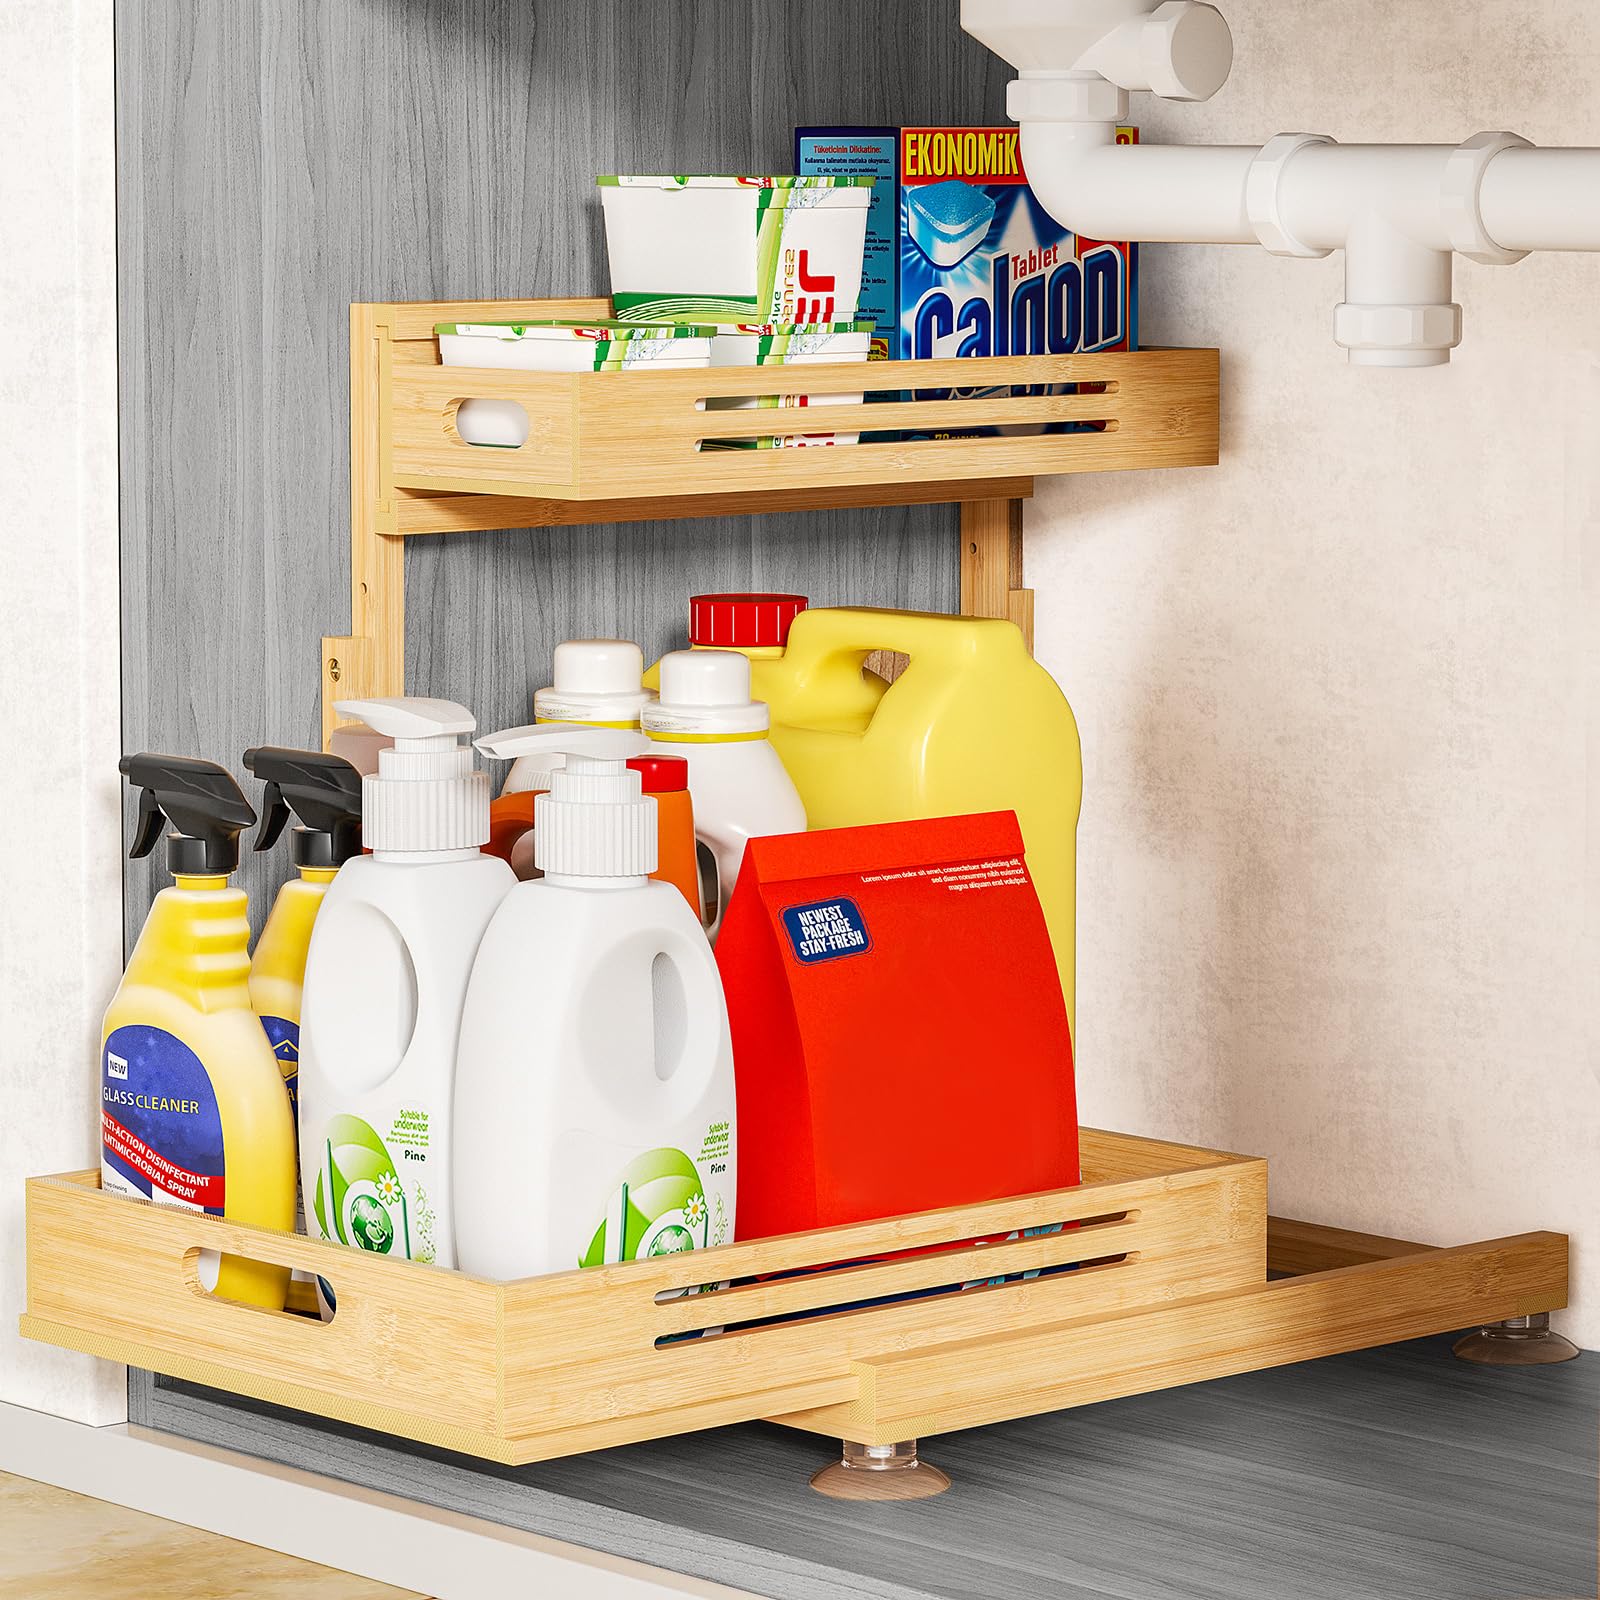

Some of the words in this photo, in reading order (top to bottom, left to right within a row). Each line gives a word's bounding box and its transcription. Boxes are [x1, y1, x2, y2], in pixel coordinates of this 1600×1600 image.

[1011, 242, 1059, 281] Tablet
[861, 874, 883, 883] Lorem
[883, 872, 902, 881] ipsum
[927, 868, 944, 876] amet,
[943, 874, 957, 882] diam
[1000, 867, 1024, 876] euismod
[948, 883, 968, 891] magna
[969, 881, 991, 890] aliquam
[798, 905, 844, 926] NEWEST
[801, 917, 853, 941] PACKAGE
[799, 929, 865, 957] STAY-FRESH
[109, 1060, 127, 1075] NEW
[103, 1086, 135, 1106] GLASS
[135, 1094, 200, 1114] CLEANER
[394, 1120, 429, 1132] underwear
[404, 1149, 426, 1161] Pine
[145, 1149, 210, 1187] DISINFECTANT
[710, 1163, 727, 1175] Pine
[167, 1179, 197, 1199] SPRAY
